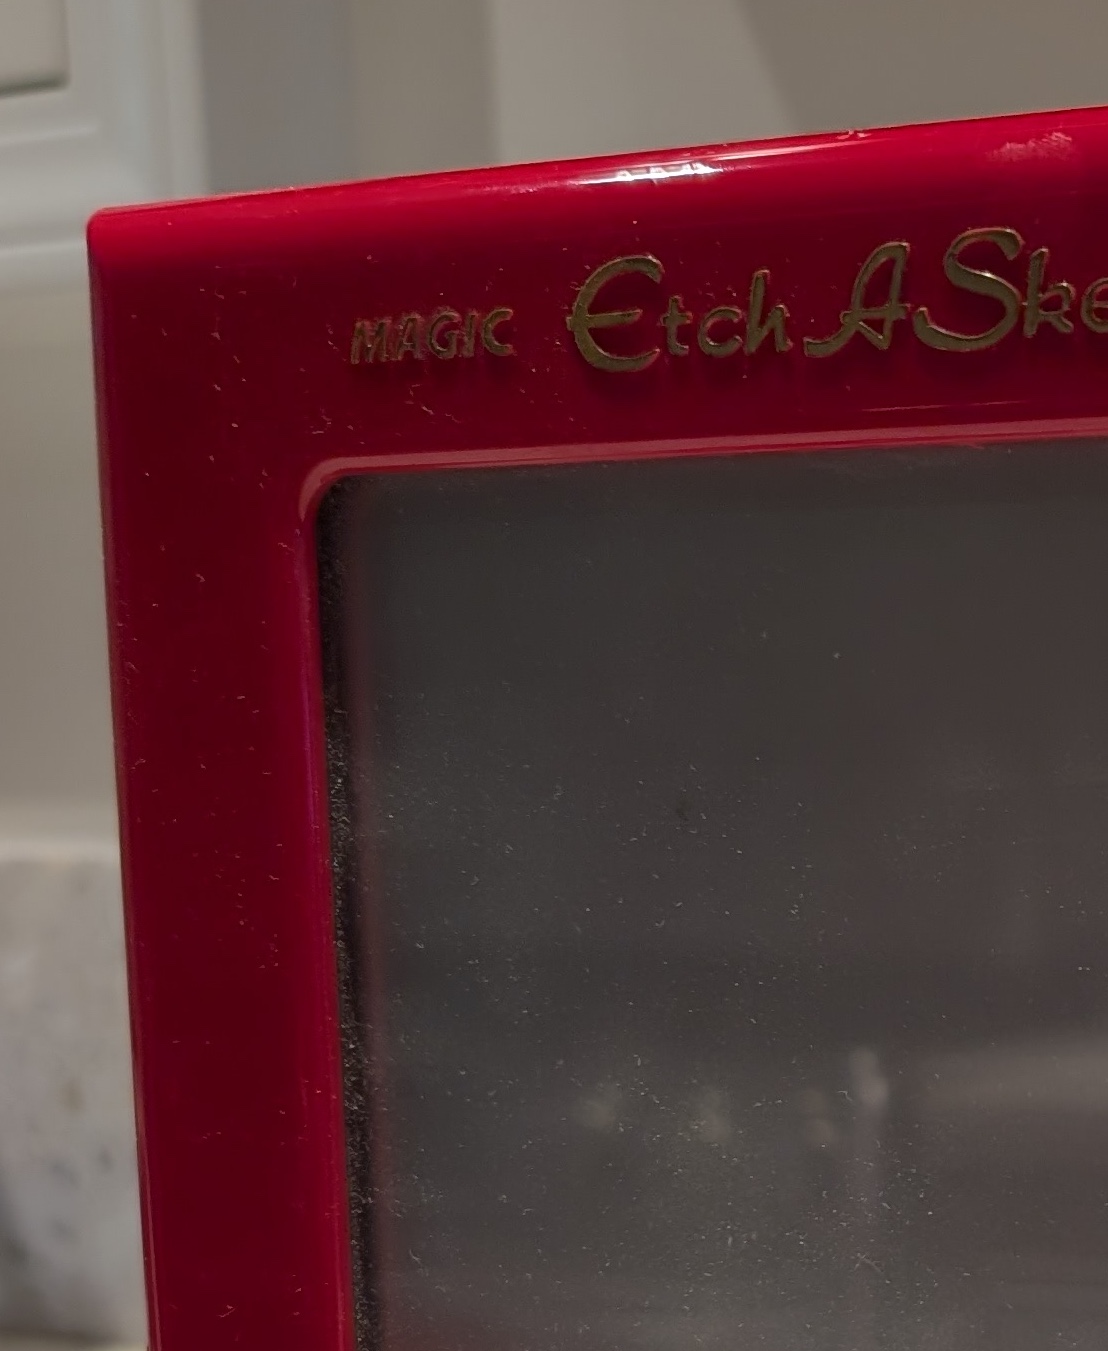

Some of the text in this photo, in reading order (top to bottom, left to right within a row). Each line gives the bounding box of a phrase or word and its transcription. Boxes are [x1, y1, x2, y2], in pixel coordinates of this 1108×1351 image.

[350, 307, 514, 365] MAGIC
[566, 253, 794, 373] Etch
[803, 241, 912, 358] A
